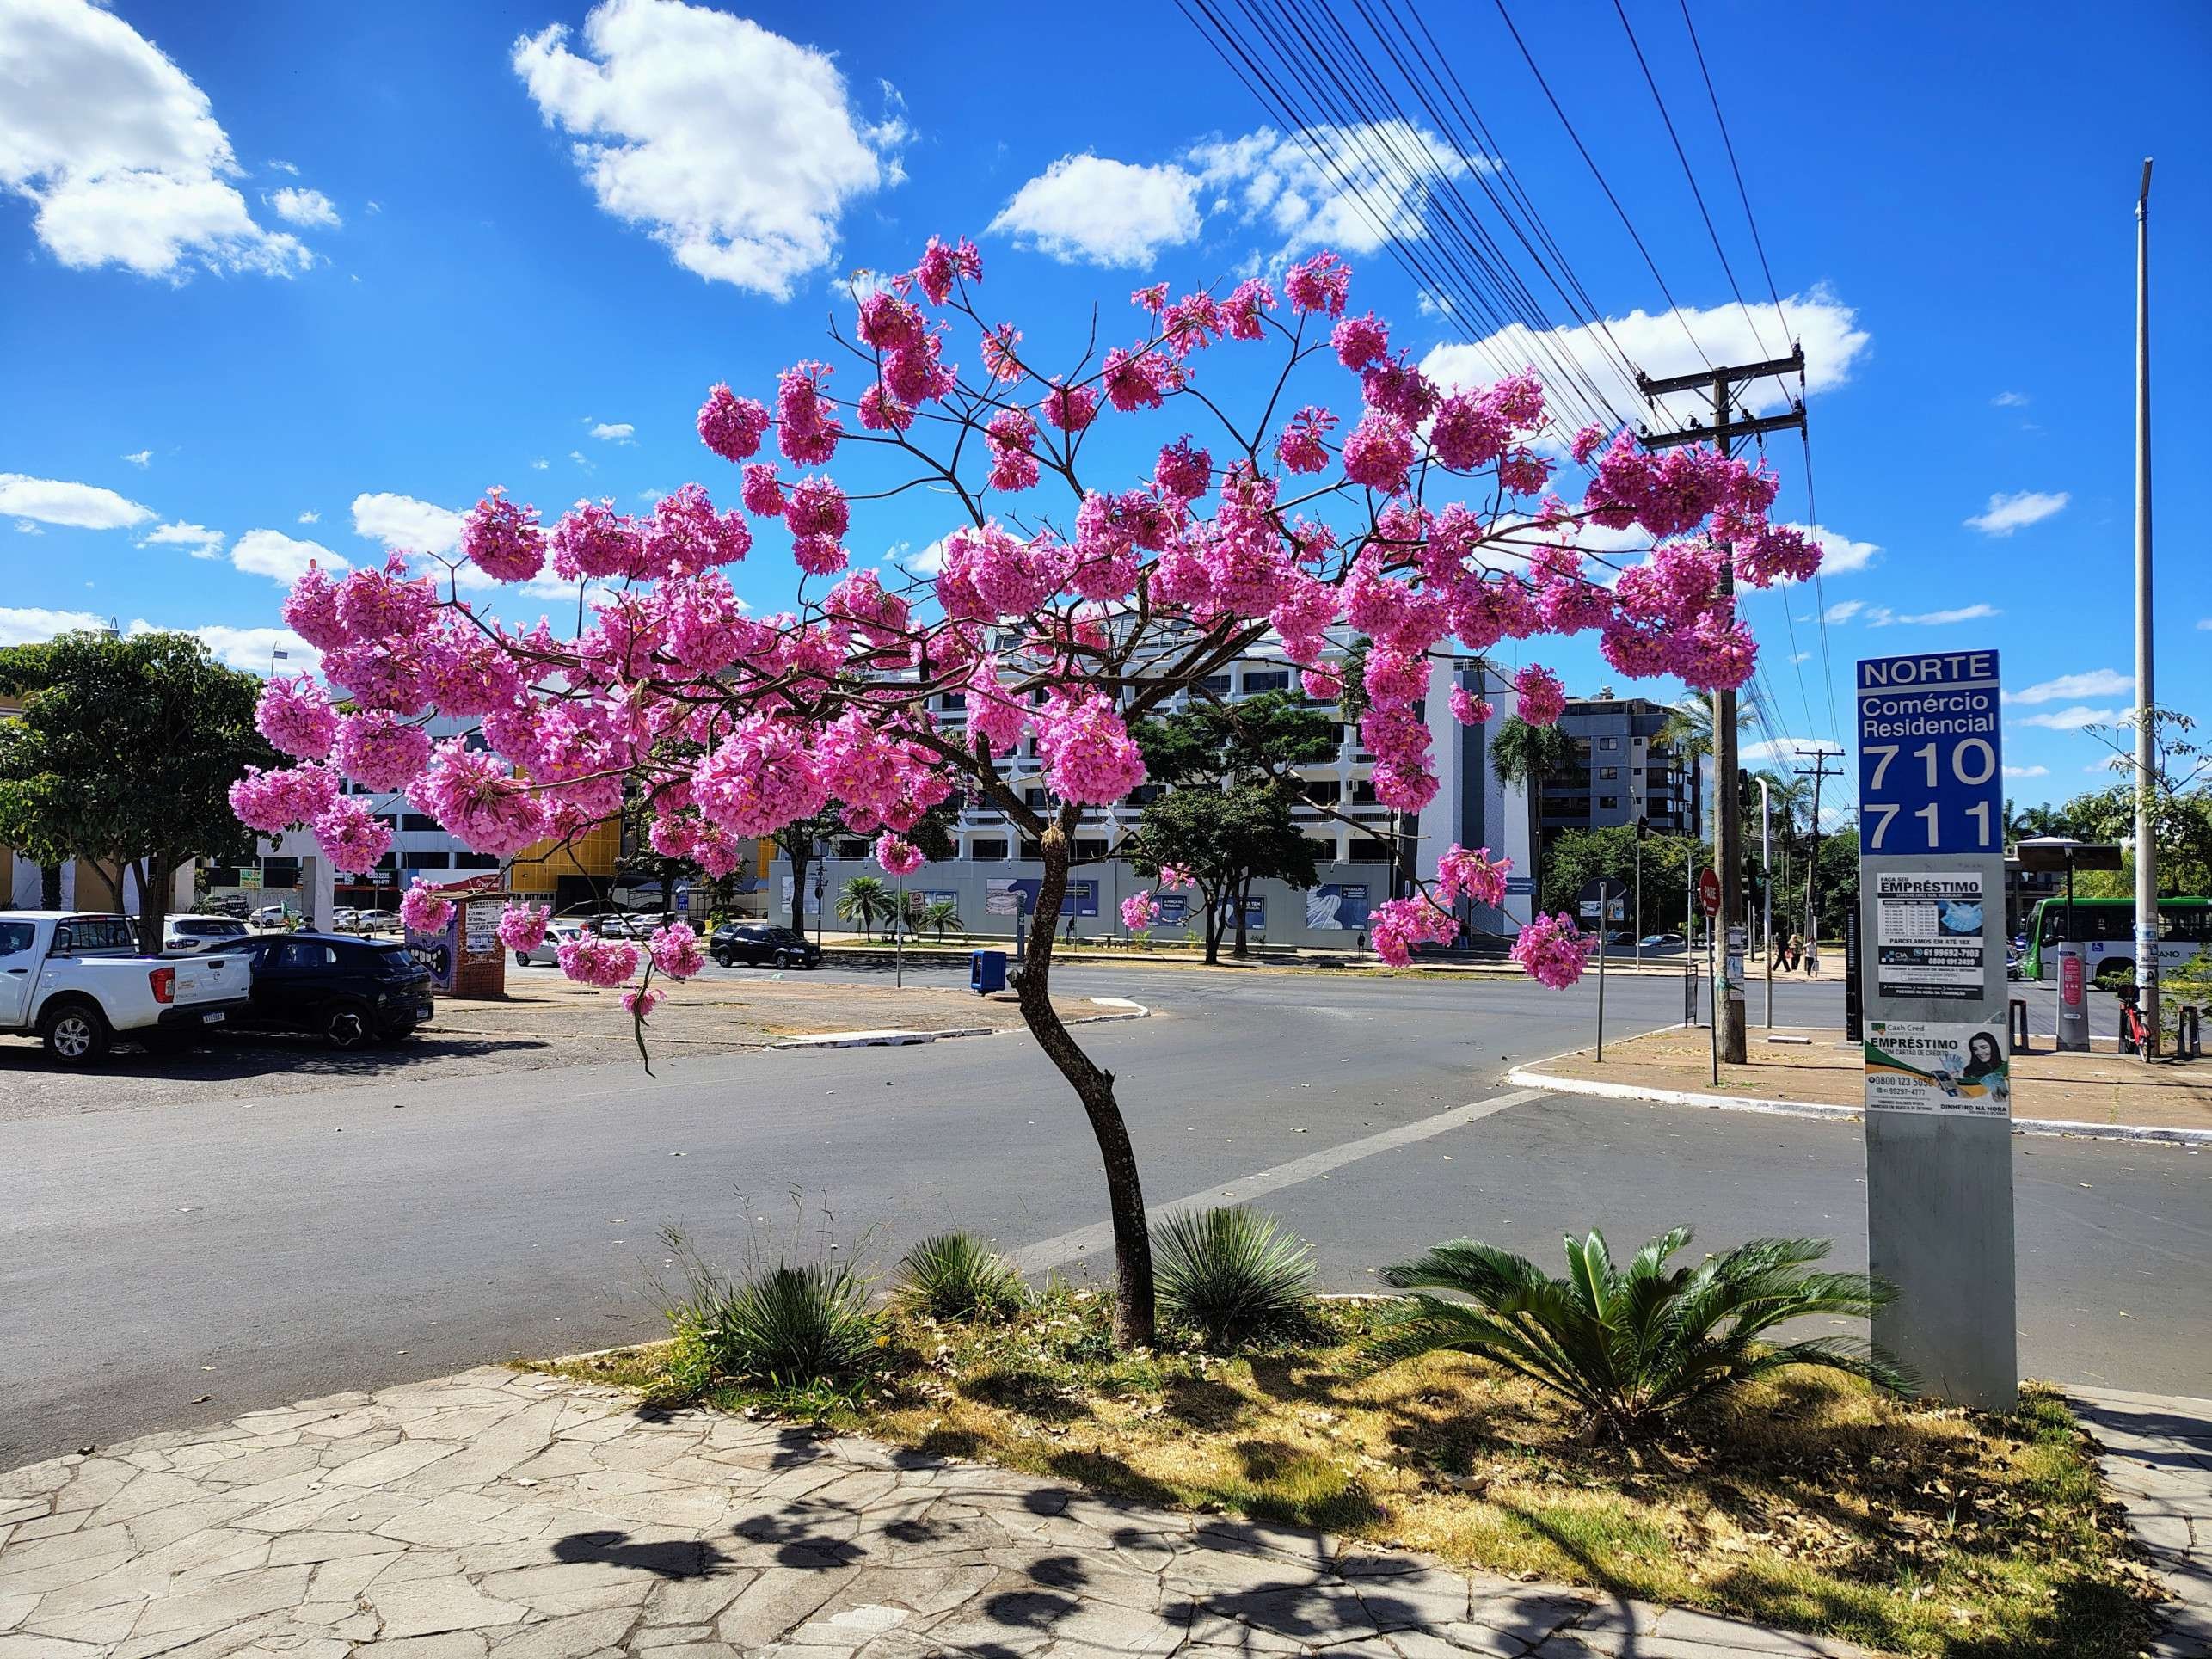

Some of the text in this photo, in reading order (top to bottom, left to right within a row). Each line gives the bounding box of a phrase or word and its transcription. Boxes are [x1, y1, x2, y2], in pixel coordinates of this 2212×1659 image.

[1865, 654, 1992, 685] NORTE
[1863, 692, 1988, 716] Comércio
[1864, 712, 1994, 738] Residencial
[1863, 738, 1996, 790] 710
[1864, 801, 1990, 849] 711
[1704, 885, 1717, 900] PARE
[1881, 880, 1979, 893] EMPRÉSTIMO
[1923, 948, 1932, 957] 61
[1871, 1036, 1958, 1050] EMPRÉSTIMO
[1876, 1076, 1896, 1085] 0800
[1898, 1078, 1911, 1086] 123
